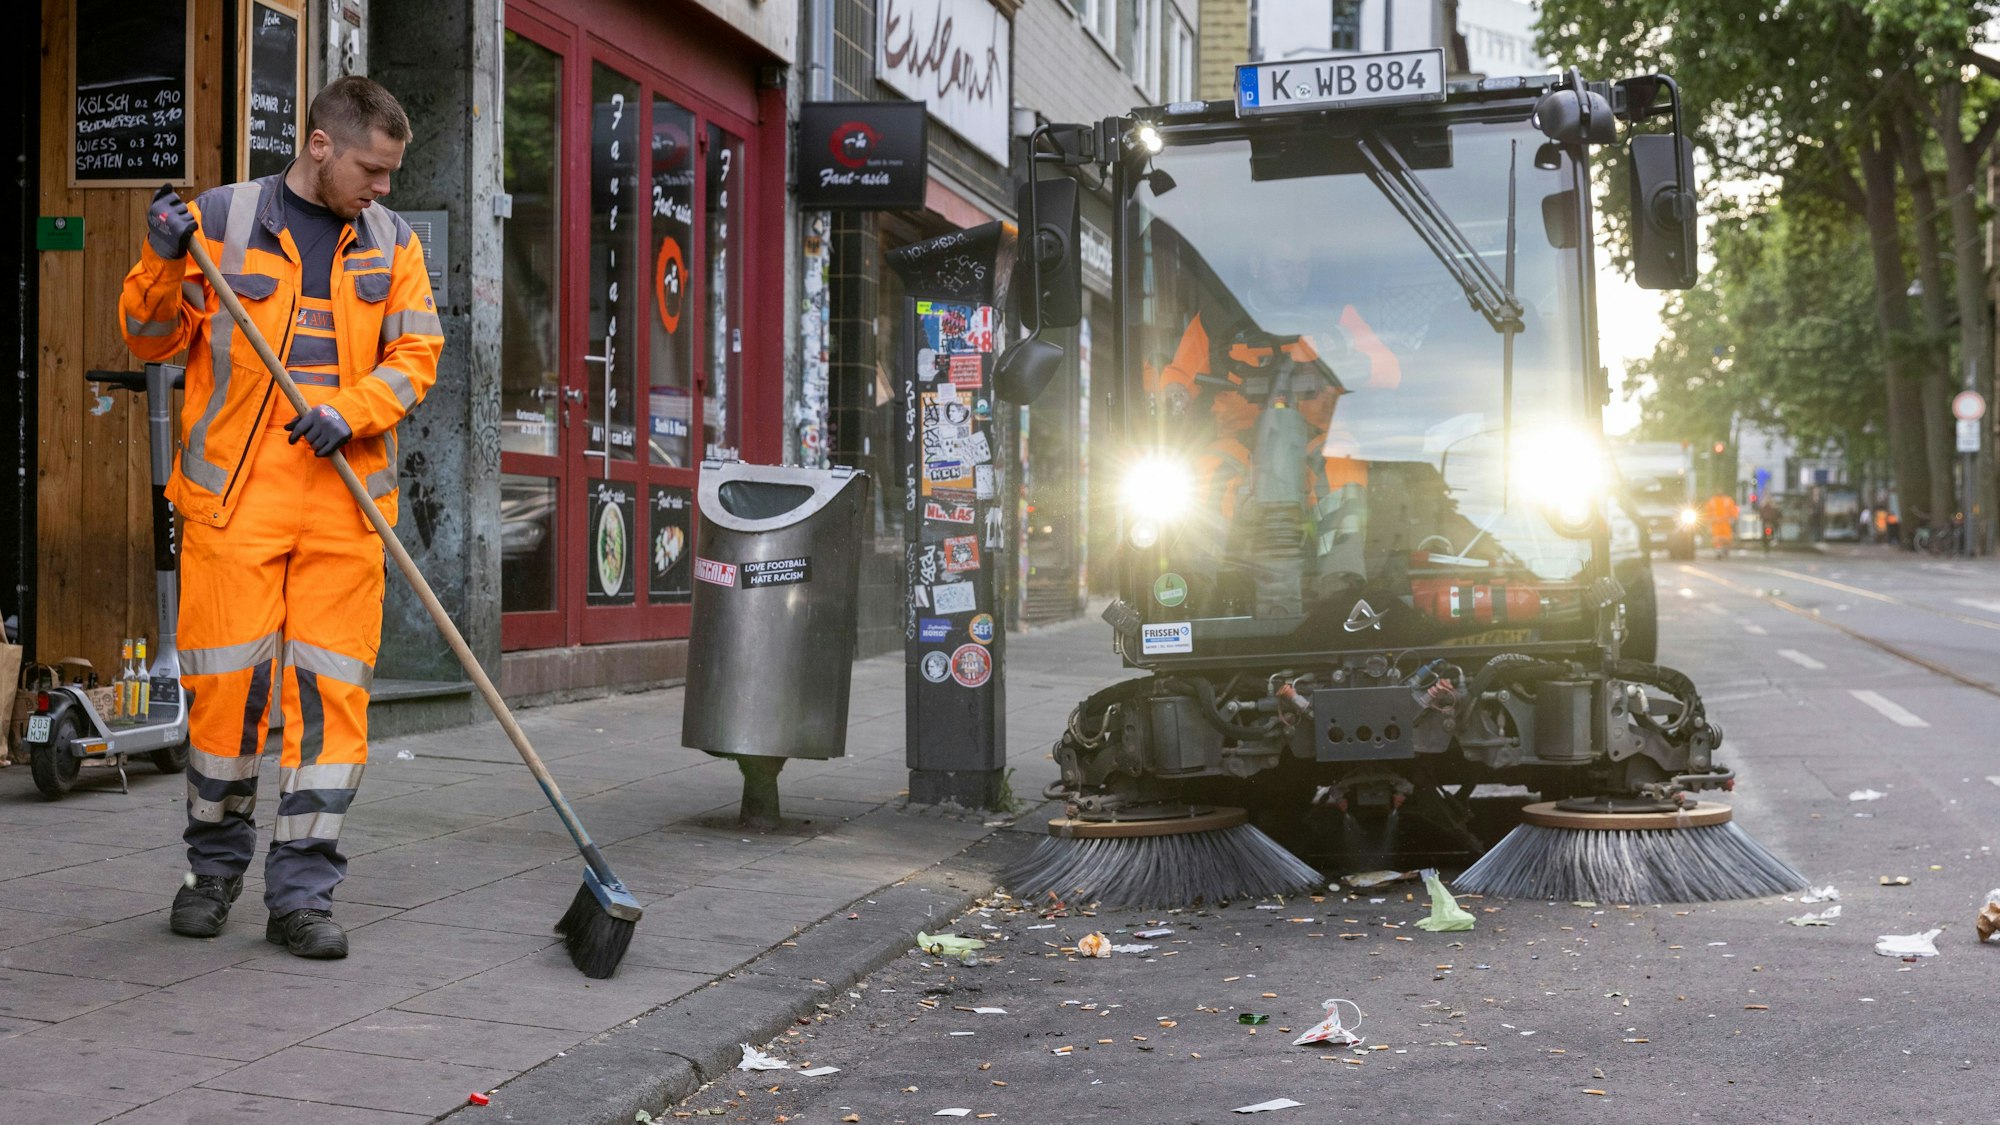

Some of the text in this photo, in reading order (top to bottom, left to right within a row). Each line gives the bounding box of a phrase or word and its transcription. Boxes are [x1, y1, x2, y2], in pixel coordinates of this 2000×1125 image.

[1272, 59, 1426, 100] K WB 884
[78, 93, 130, 115] KÖLSCH
[154, 90, 181, 107] 1,90
[1246, 92, 1254, 100] D
[77, 132, 177, 153] WIESS 0.3 2,70
[76, 152, 179, 171] SPATEN 0.5 4,90
[820, 168, 891, 188] Fant-asia
[612, 432, 623, 445] can
[623, 430, 633, 447] Eat
[745, 559, 807, 573] LOVE FOOTBALL
[751, 571, 803, 584] HATE RACISM
[1144, 628, 1180, 638] FRISSEN
